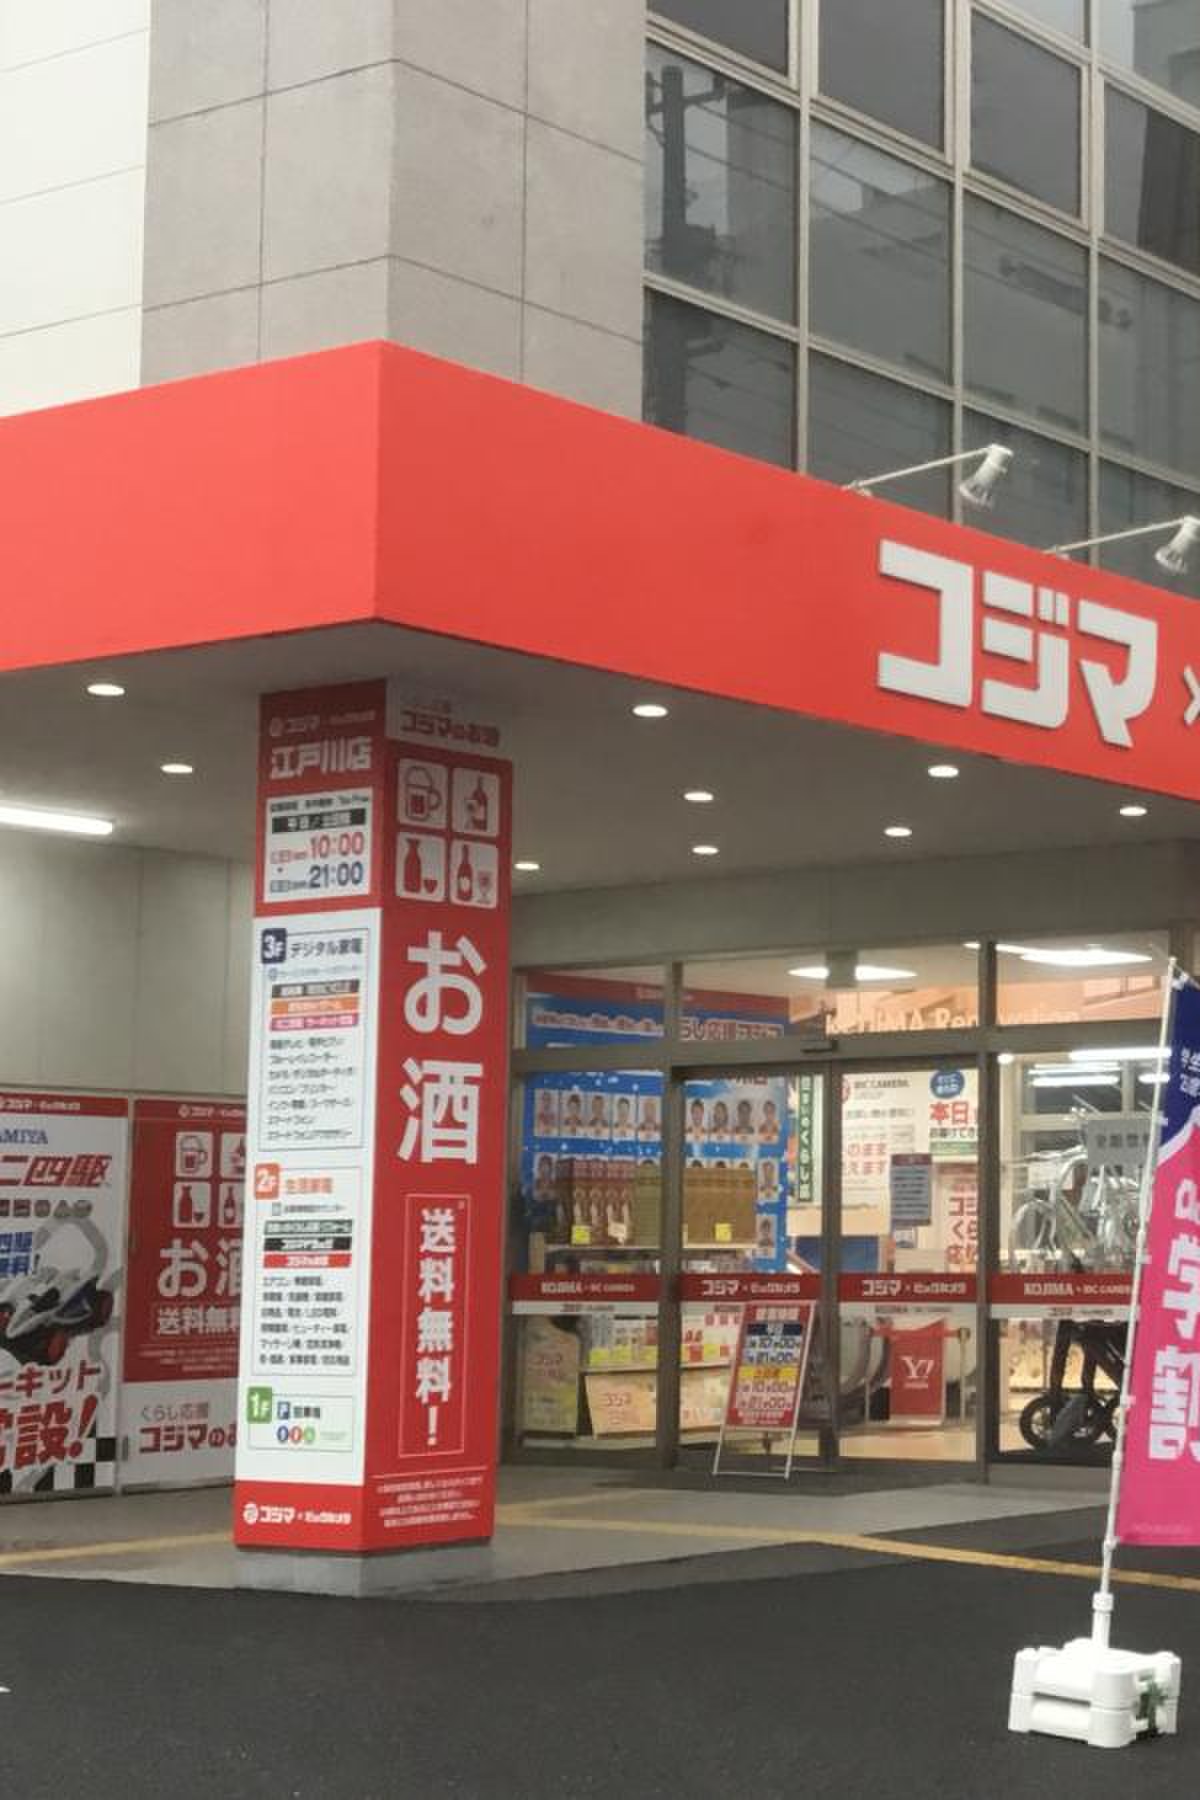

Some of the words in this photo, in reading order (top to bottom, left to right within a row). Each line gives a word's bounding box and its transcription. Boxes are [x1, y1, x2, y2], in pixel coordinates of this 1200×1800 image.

[878, 539, 1157, 747] コジマ
[271, 737, 372, 779] 江戸川店
[310, 832, 365, 861] 10:00
[308, 860, 364, 890] 21:00
[398, 931, 486, 1165] お酒
[0, 1128, 48, 1144] MIYA
[415, 1208, 456, 1446] 送料無料!
